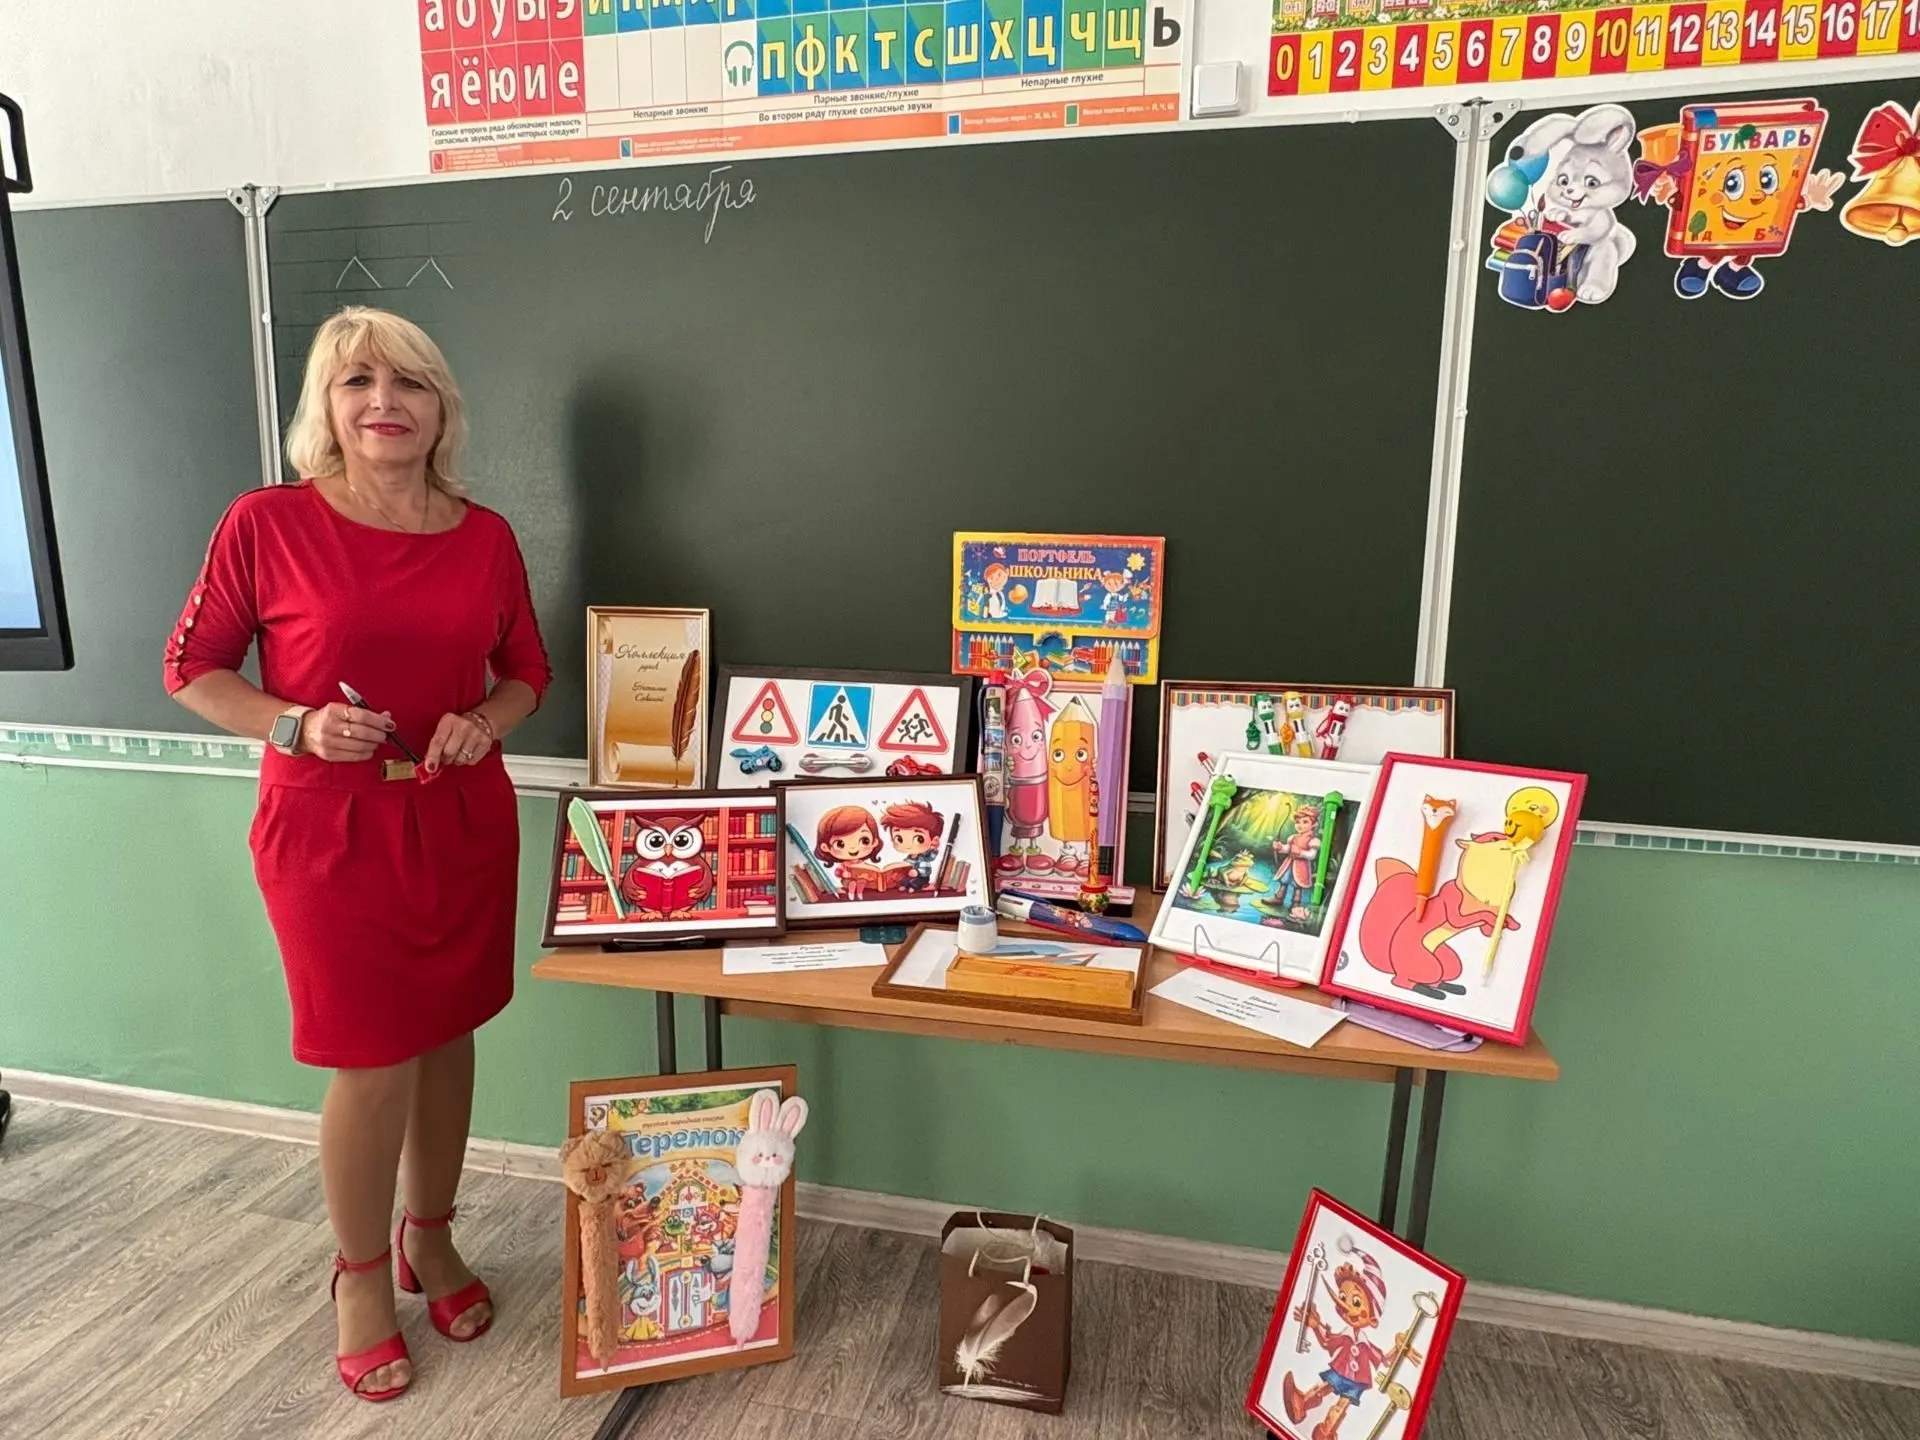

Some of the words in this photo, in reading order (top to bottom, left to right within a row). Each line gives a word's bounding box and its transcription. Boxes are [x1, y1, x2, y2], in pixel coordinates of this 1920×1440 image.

[425, 0, 445, 31] а
[456, 0, 477, 28] о
[762, 41, 786, 80] п
[794, 24, 826, 91] ф
[835, 34, 860, 74] к
[873, 31, 897, 70] т
[914, 28, 935, 68] с
[946, 23, 979, 66] ш
[990, 18, 1016, 61] х
[1027, 15, 1056, 66] ц
[1070, 11, 1096, 53] ч
[1107, 7, 1142, 60] щ
[1153, 6, 1182, 48] ь
[1276, 43, 1295, 81] 0
[1308, 40, 1324, 79] 1
[1336, 40, 1356, 78] 2
[1368, 36, 1388, 75] 3
[1399, 33, 1420, 72] 4
[1432, 31, 1454, 70] 5
[1466, 29, 1486, 69] 6
[1500, 27, 1521, 66] 7
[1532, 24, 1552, 64] 8
[1565, 21, 1588, 62] 9
[1596, 18, 1628, 58] 10
[1634, 15, 1663, 56] 11
[1669, 14, 1701, 54] 12
[1707, 10, 1739, 50] 13
[1744, 8, 1777, 48] 14
[1782, 5, 1817, 45] 15
[1822, 2, 1856, 42] 16
[1862, 0, 1897, 40] 17
[1904, 0, 1920, 36] 1
[430, 72, 451, 109] я
[461, 56, 481, 106] ё
[489, 66, 516, 104] ю
[524, 63, 547, 100] и
[558, 61, 579, 98] е
[1021, 75, 1069, 89] Непарные
[1071, 72, 1104, 85] глухие
[814, 94, 848, 105] Парные
[850, 88, 919, 102] звонкие/глухие
[633, 109, 674, 120] Непарные
[675, 106, 709, 115] звонкие
[758, 113, 770, 122] Во
[772, 111, 803, 121] втором
[805, 109, 826, 119] ряду
[828, 108, 858, 118] глухие
[859, 104, 905, 115] согласные
[907, 102, 933, 112] звуки
[431, 128, 459, 137] Гласные
[460, 127, 487, 135] второго
[489, 125, 505, 134] ряда
[507, 121, 548, 130] обозначают
[435, 137, 469, 145] согласных
[496, 132, 516, 141] после
[517, 131, 547, 140] которых
[549, 128, 580, 136] следуют
[1703, 129, 1812, 152] БУКВАРЬ
[552, 177, 574, 221] 2
[591, 165, 757, 244] сентября
[1753, 228, 1767, 241] Б
[1009, 564, 1103, 581] ШКОЛЬНИКА
[614, 644, 685, 662] Коллекция
[623, 1127, 746, 1159] Теремок
